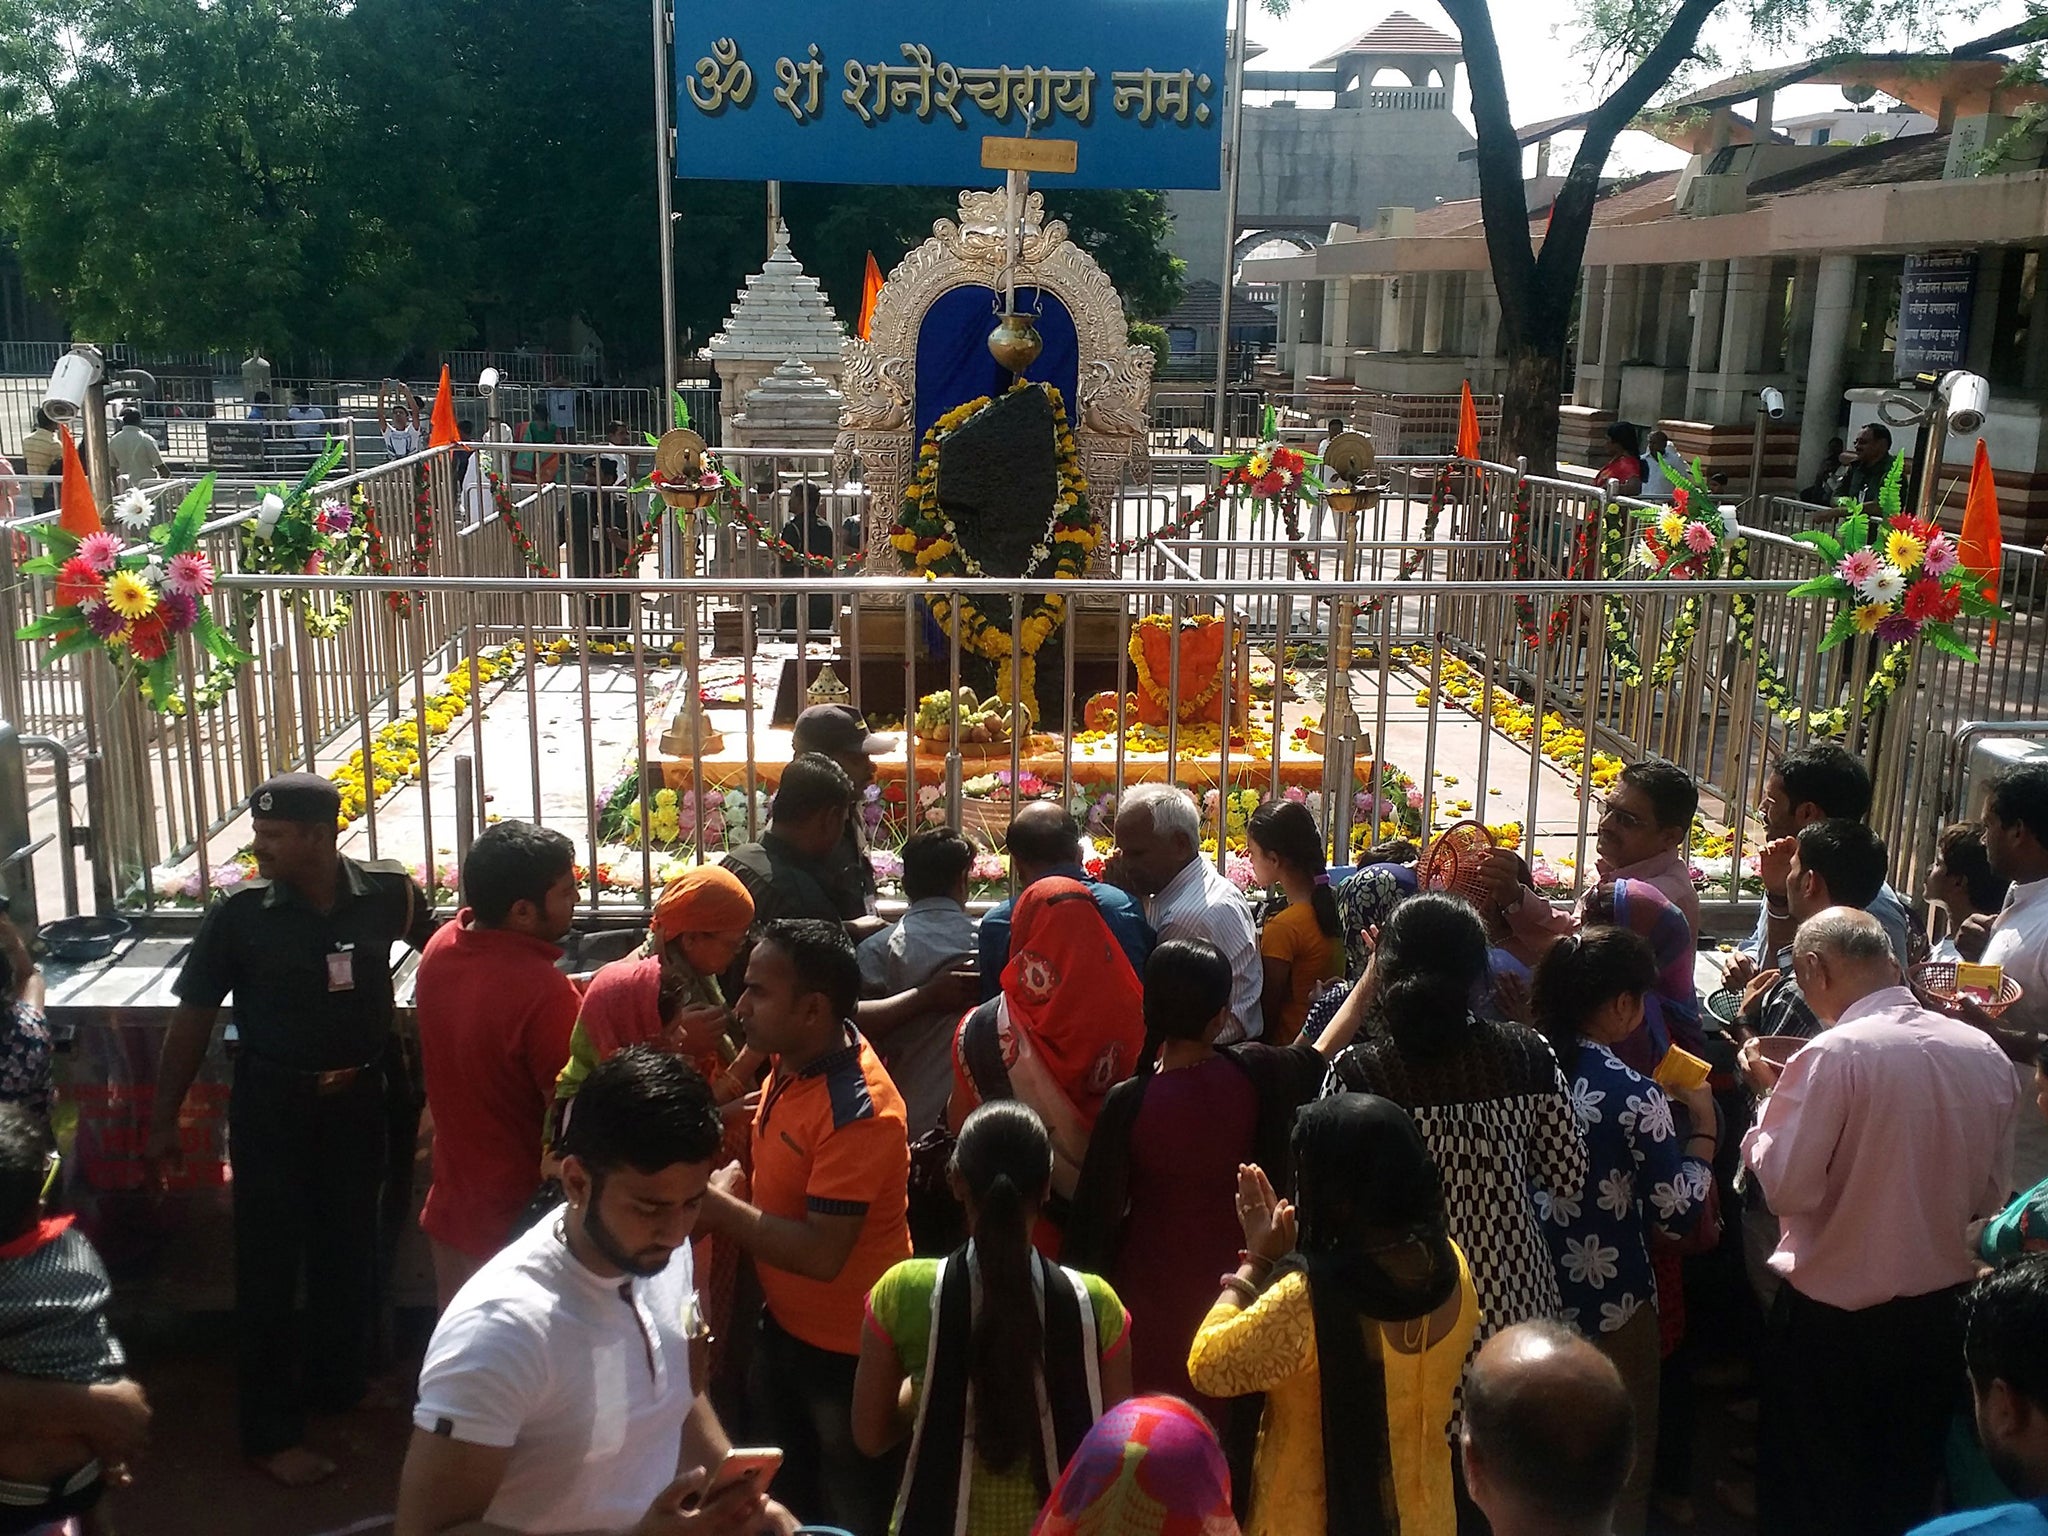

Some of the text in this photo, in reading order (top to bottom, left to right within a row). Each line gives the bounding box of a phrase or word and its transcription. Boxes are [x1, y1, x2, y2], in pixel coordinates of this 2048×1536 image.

[686, 36, 1212, 125] ॐ शं शनैश्चराय नमः
